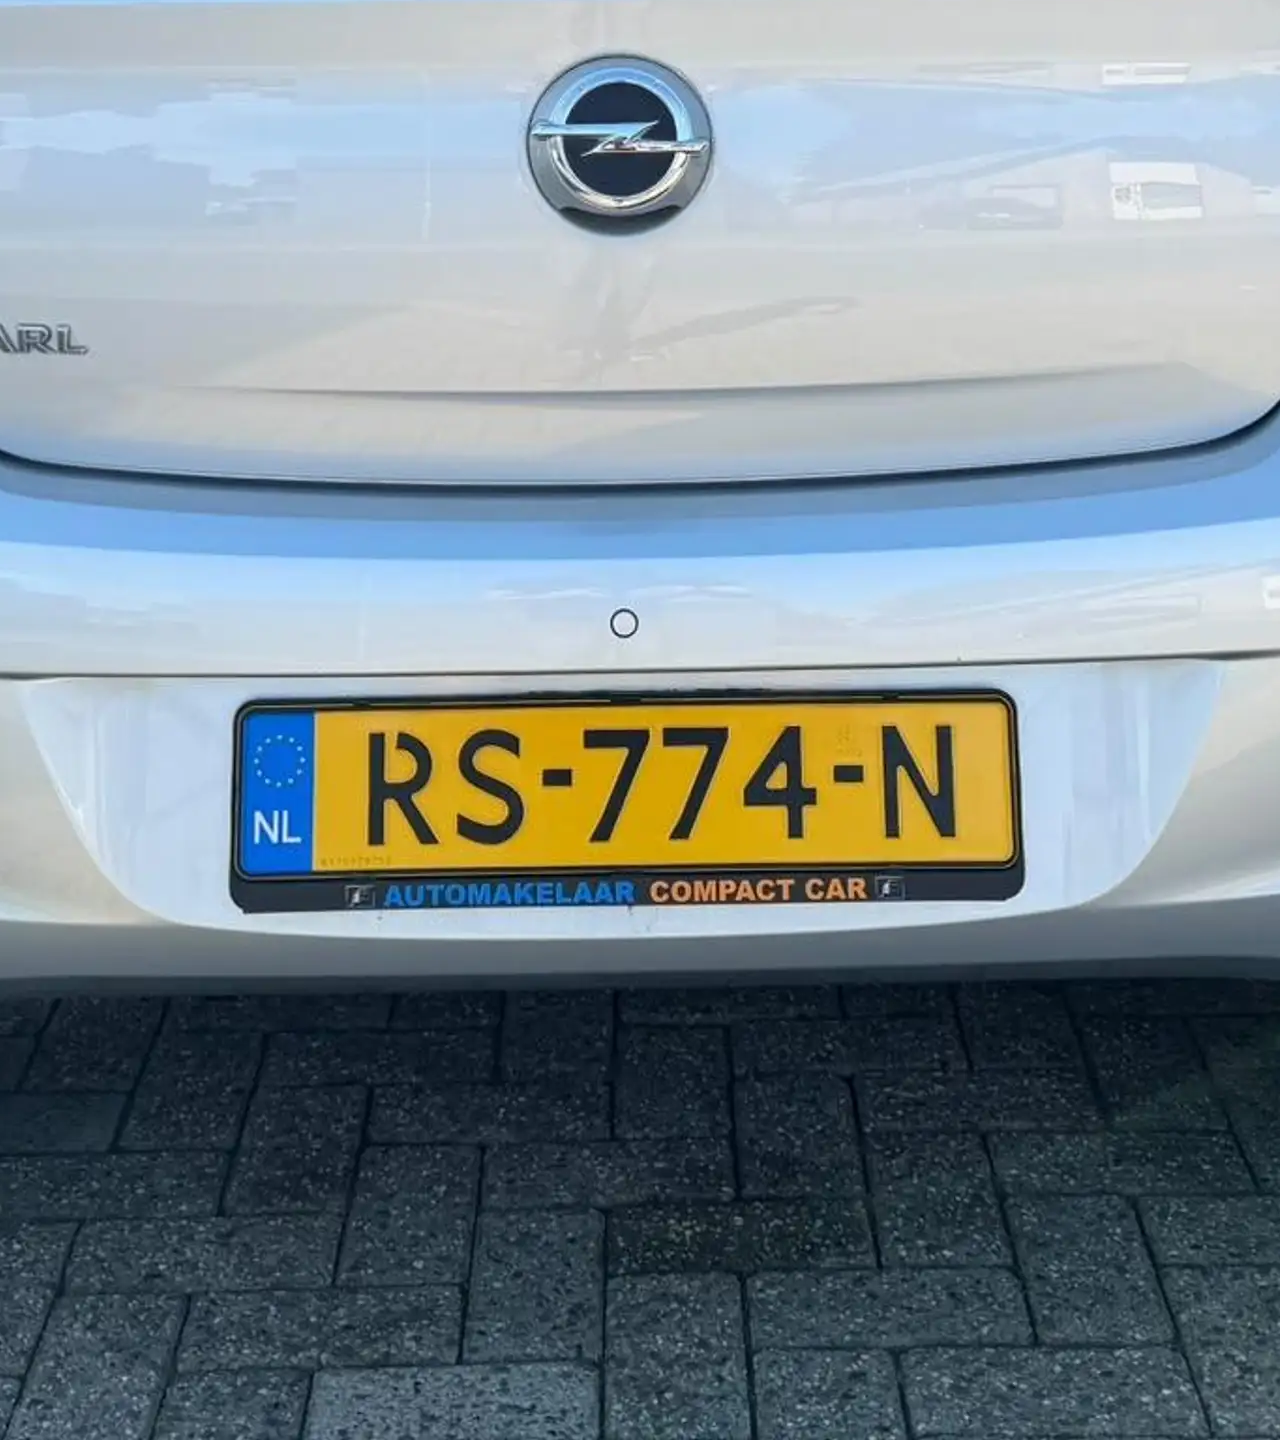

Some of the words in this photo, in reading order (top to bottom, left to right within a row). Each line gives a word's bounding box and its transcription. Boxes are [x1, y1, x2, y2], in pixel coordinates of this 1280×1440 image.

[253, 809, 302, 845] NL
[367, 725, 957, 846] RS-774-N
[383, 881, 635, 907] AUTOMAKELAAR
[649, 879, 795, 903] COMPACT
[804, 877, 868, 901] CAR
